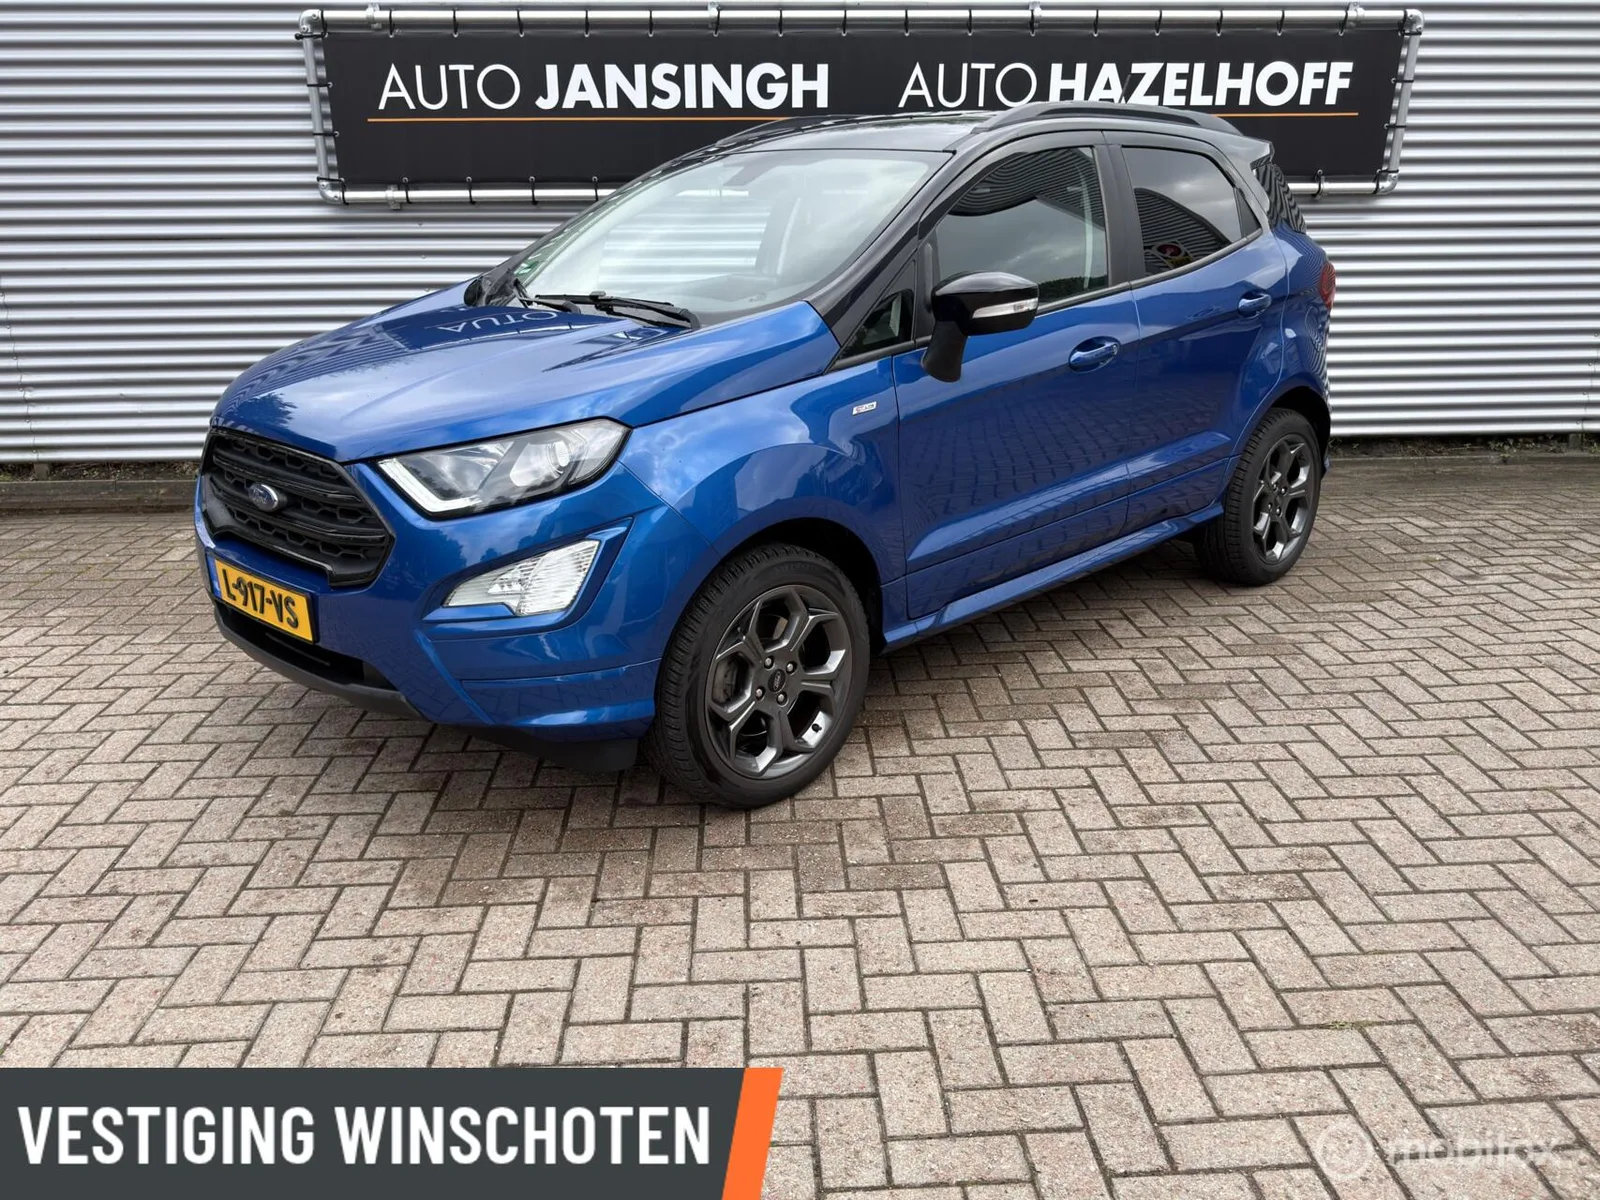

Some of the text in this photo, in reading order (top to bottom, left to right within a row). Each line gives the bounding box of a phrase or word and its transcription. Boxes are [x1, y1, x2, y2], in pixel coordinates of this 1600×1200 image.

[378, 62, 829, 111] AUTO JANSINGH
[897, 60, 1354, 107] AUTO HAZELHOFF
[221, 568, 300, 630] L-917-VS
